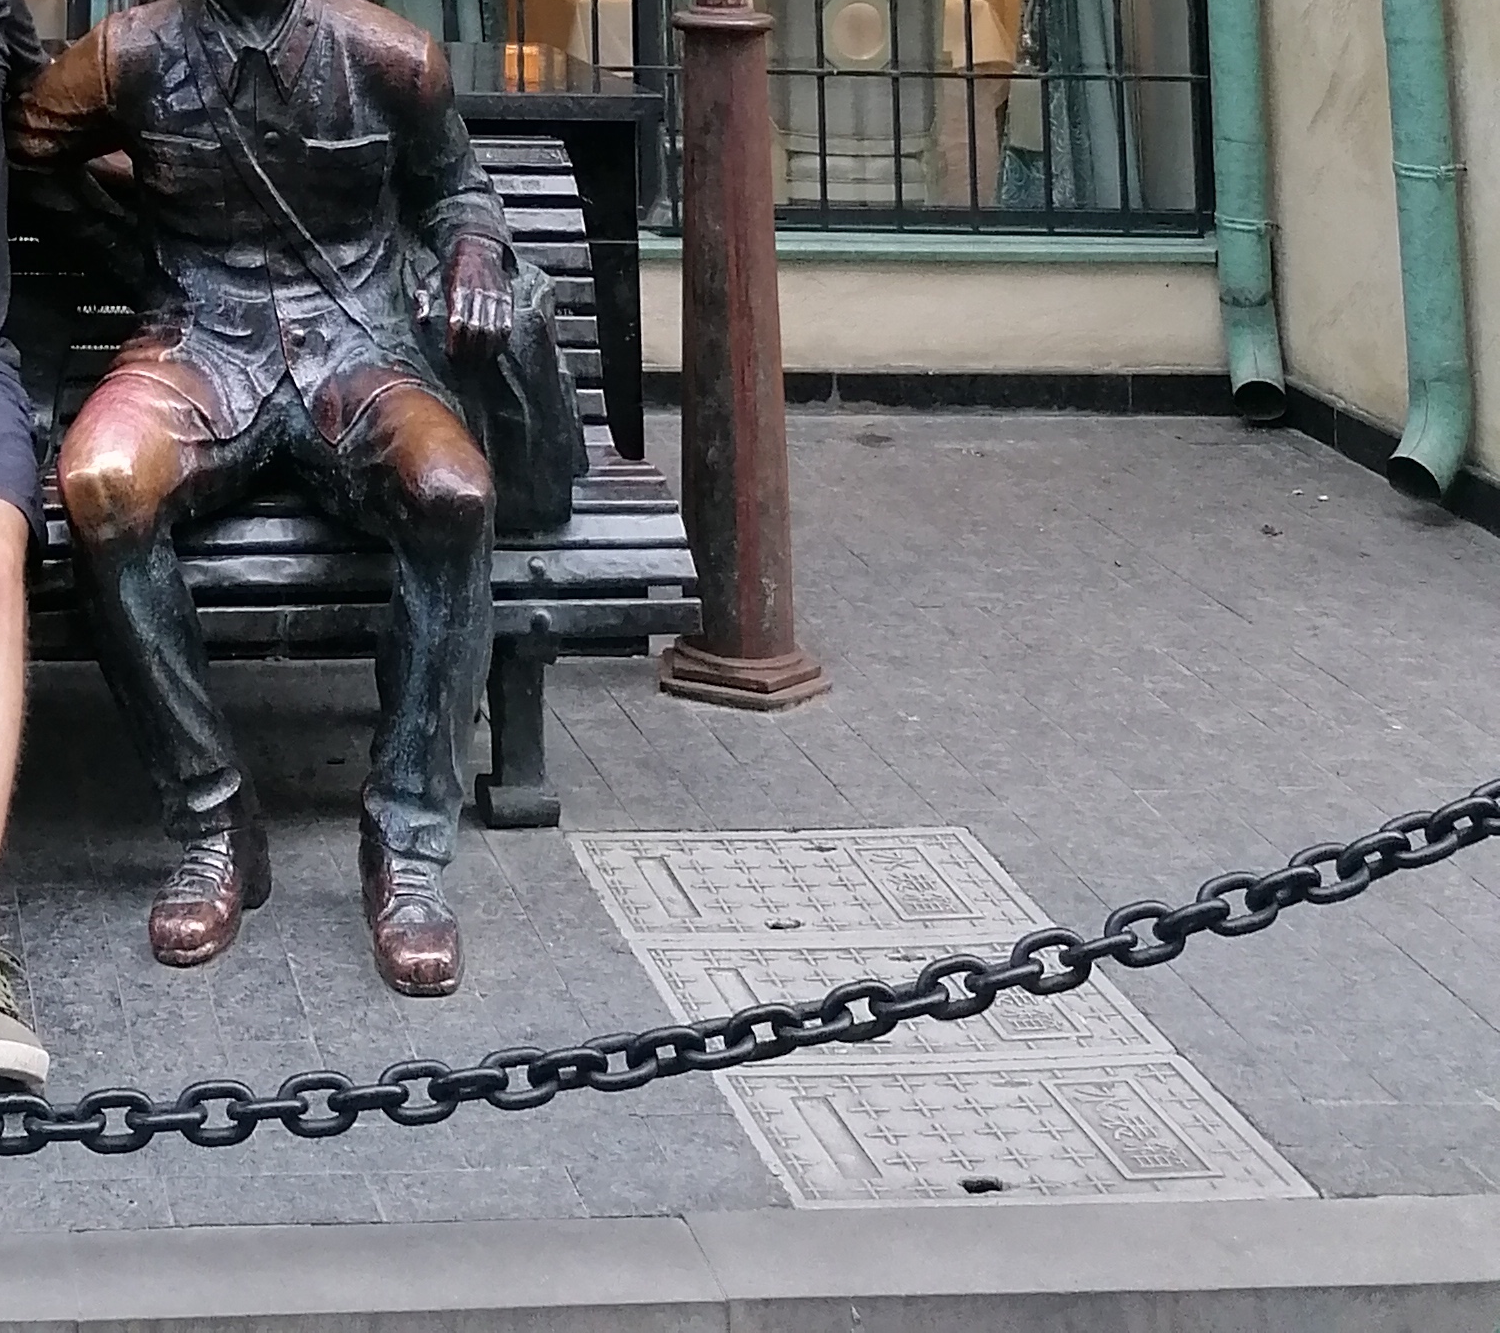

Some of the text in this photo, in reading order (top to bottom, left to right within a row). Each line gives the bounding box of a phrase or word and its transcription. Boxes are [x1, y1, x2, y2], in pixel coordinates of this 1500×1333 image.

[995, 986, 1064, 1031] 表箱
[1072, 1086, 1189, 1167] 水表箱
